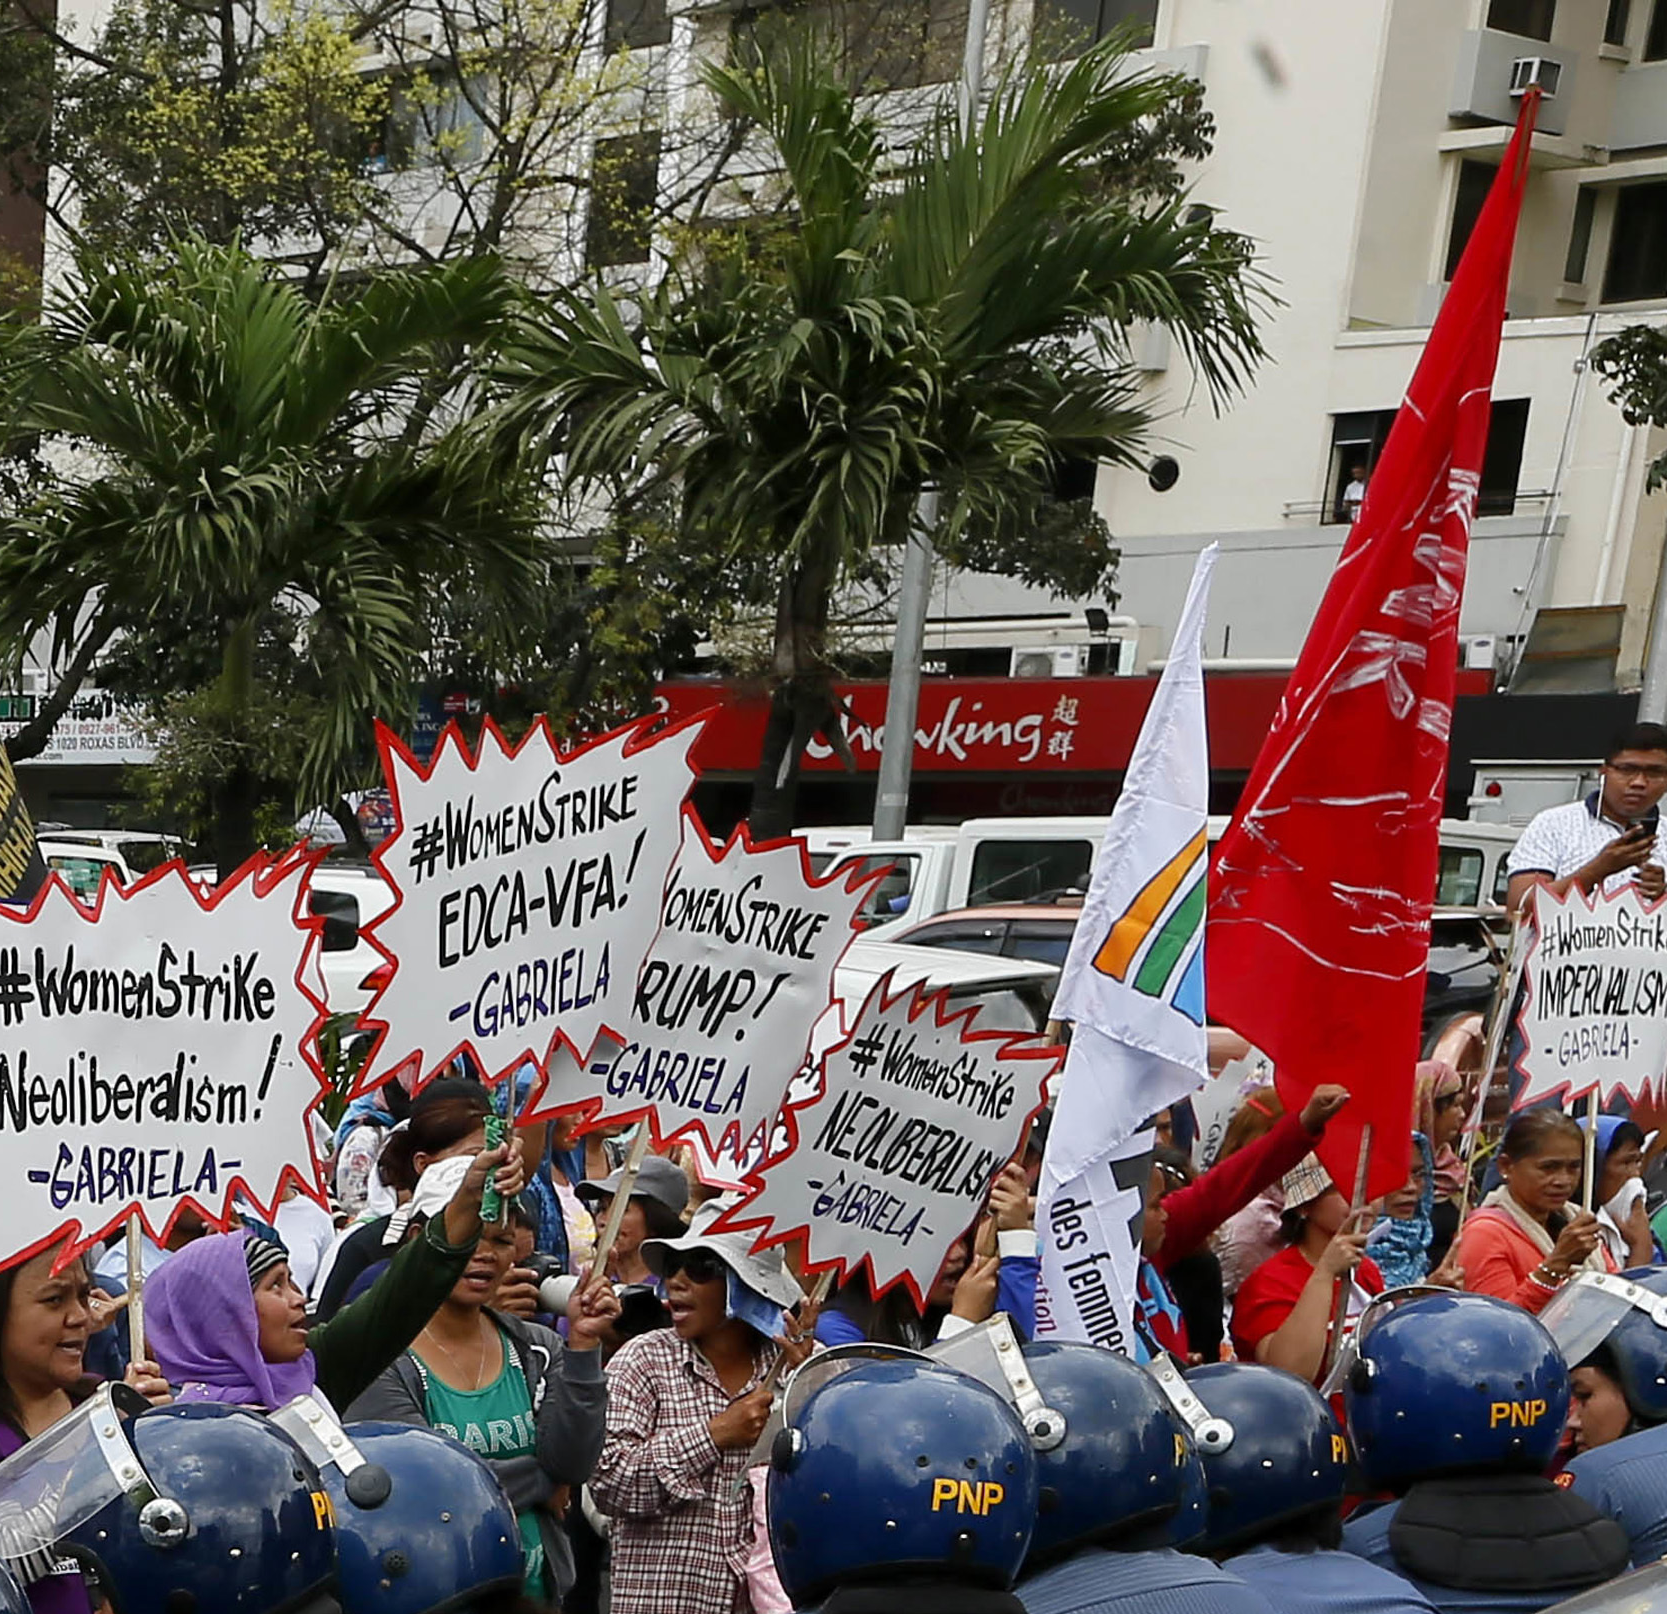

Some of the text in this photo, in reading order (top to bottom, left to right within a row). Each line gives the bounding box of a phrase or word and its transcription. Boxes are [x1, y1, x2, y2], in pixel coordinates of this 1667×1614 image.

[80, 737, 116, 750] ROXAS
[409, 769, 640, 885] #WOMENSTRIKE
[439, 828, 648, 968] EDCA-VFA!
[1542, 907, 1667, 962] #WomenStrik
[1049, 1196, 1093, 1252] des
[1490, 1398, 1547, 1429] PNP
[930, 1477, 1005, 1517] PNP
